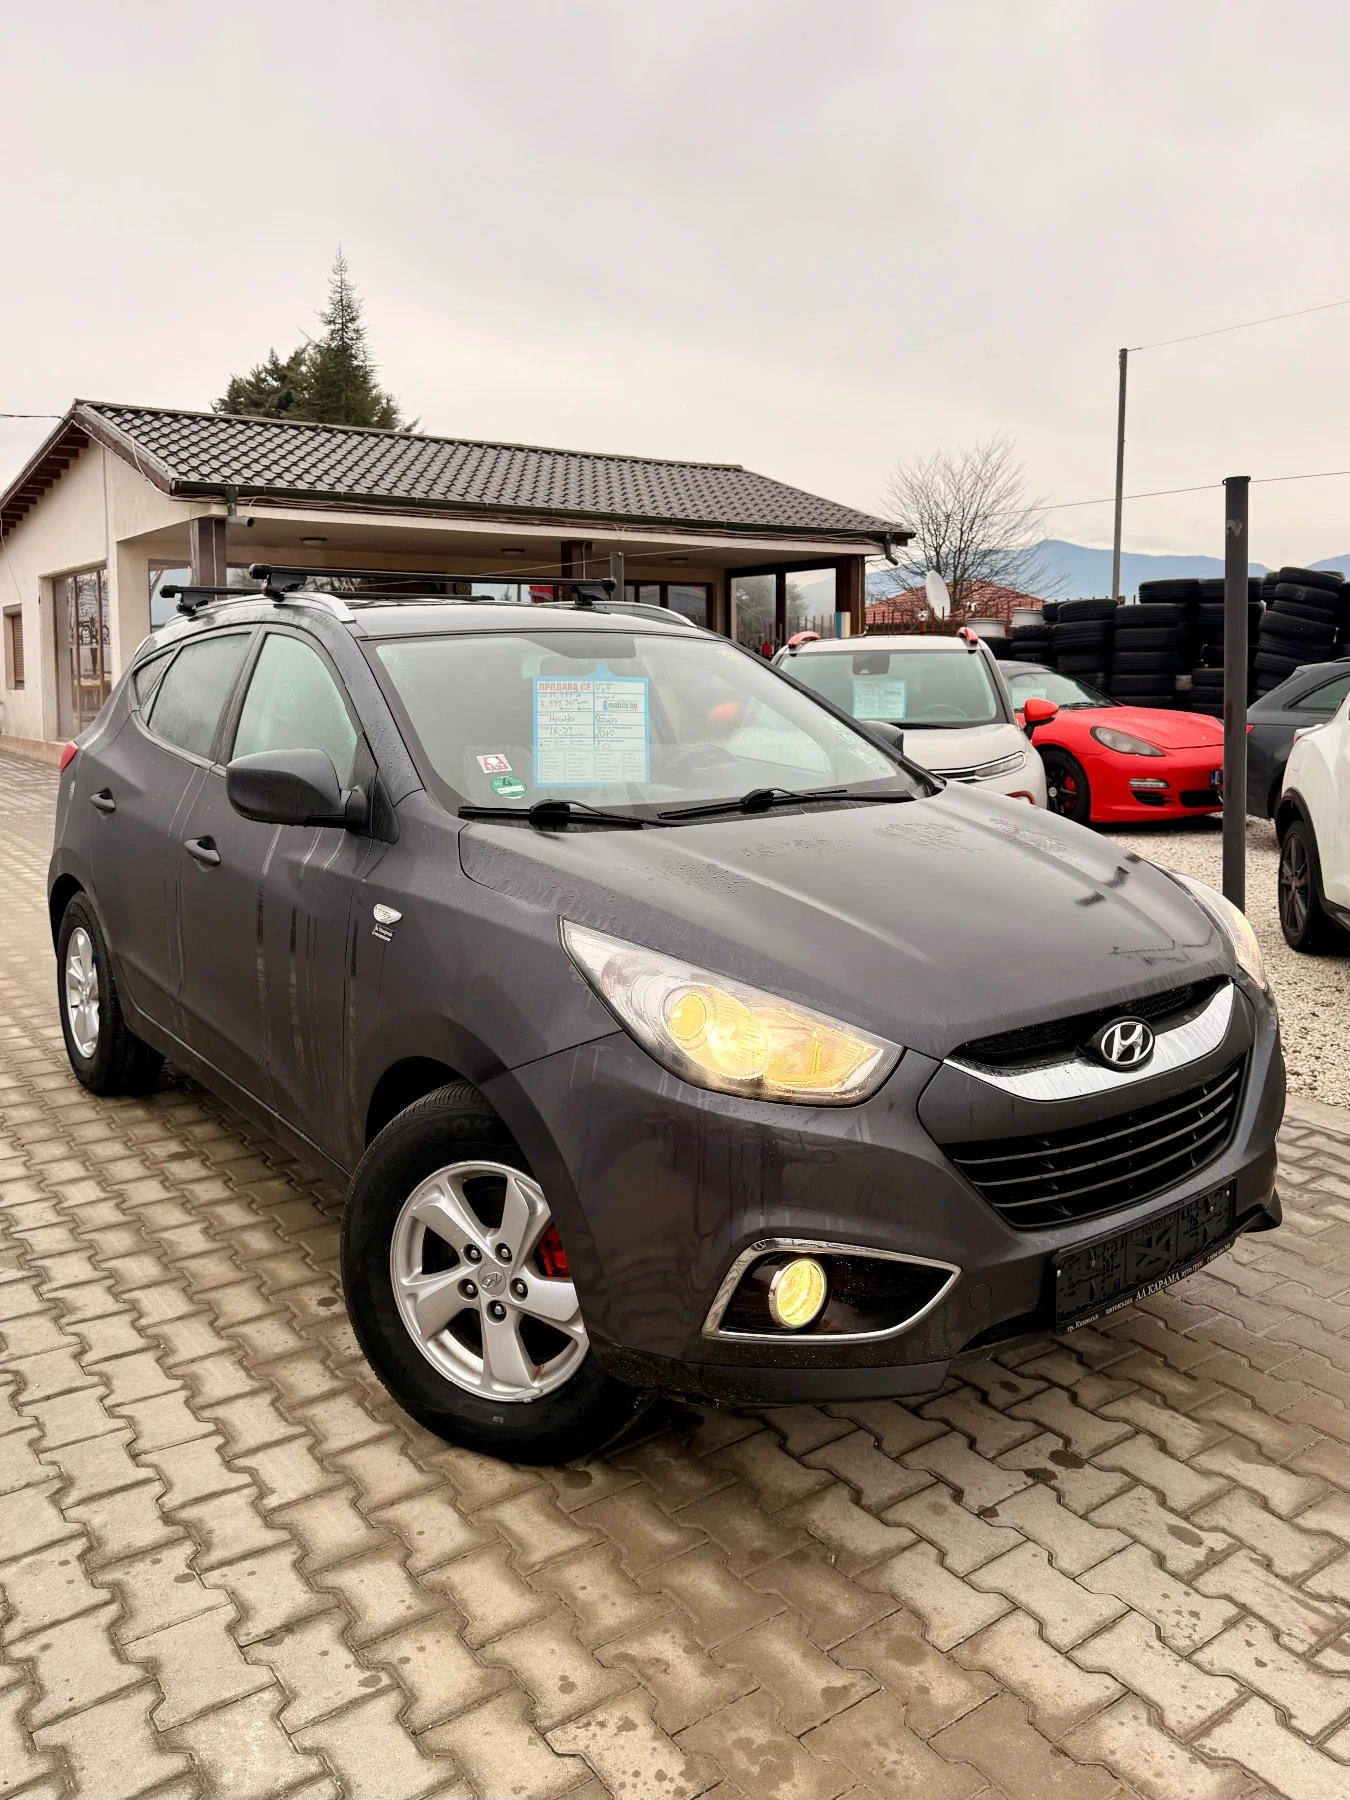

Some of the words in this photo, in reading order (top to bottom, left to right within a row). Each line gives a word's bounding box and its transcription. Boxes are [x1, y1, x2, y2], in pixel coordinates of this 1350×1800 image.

[539, 682, 578, 691] ПРОДАВА
[580, 682, 592, 691] СЕ
[608, 701, 638, 710] mobile.bg
[1147, 1272, 1180, 1296] КАРАМА
